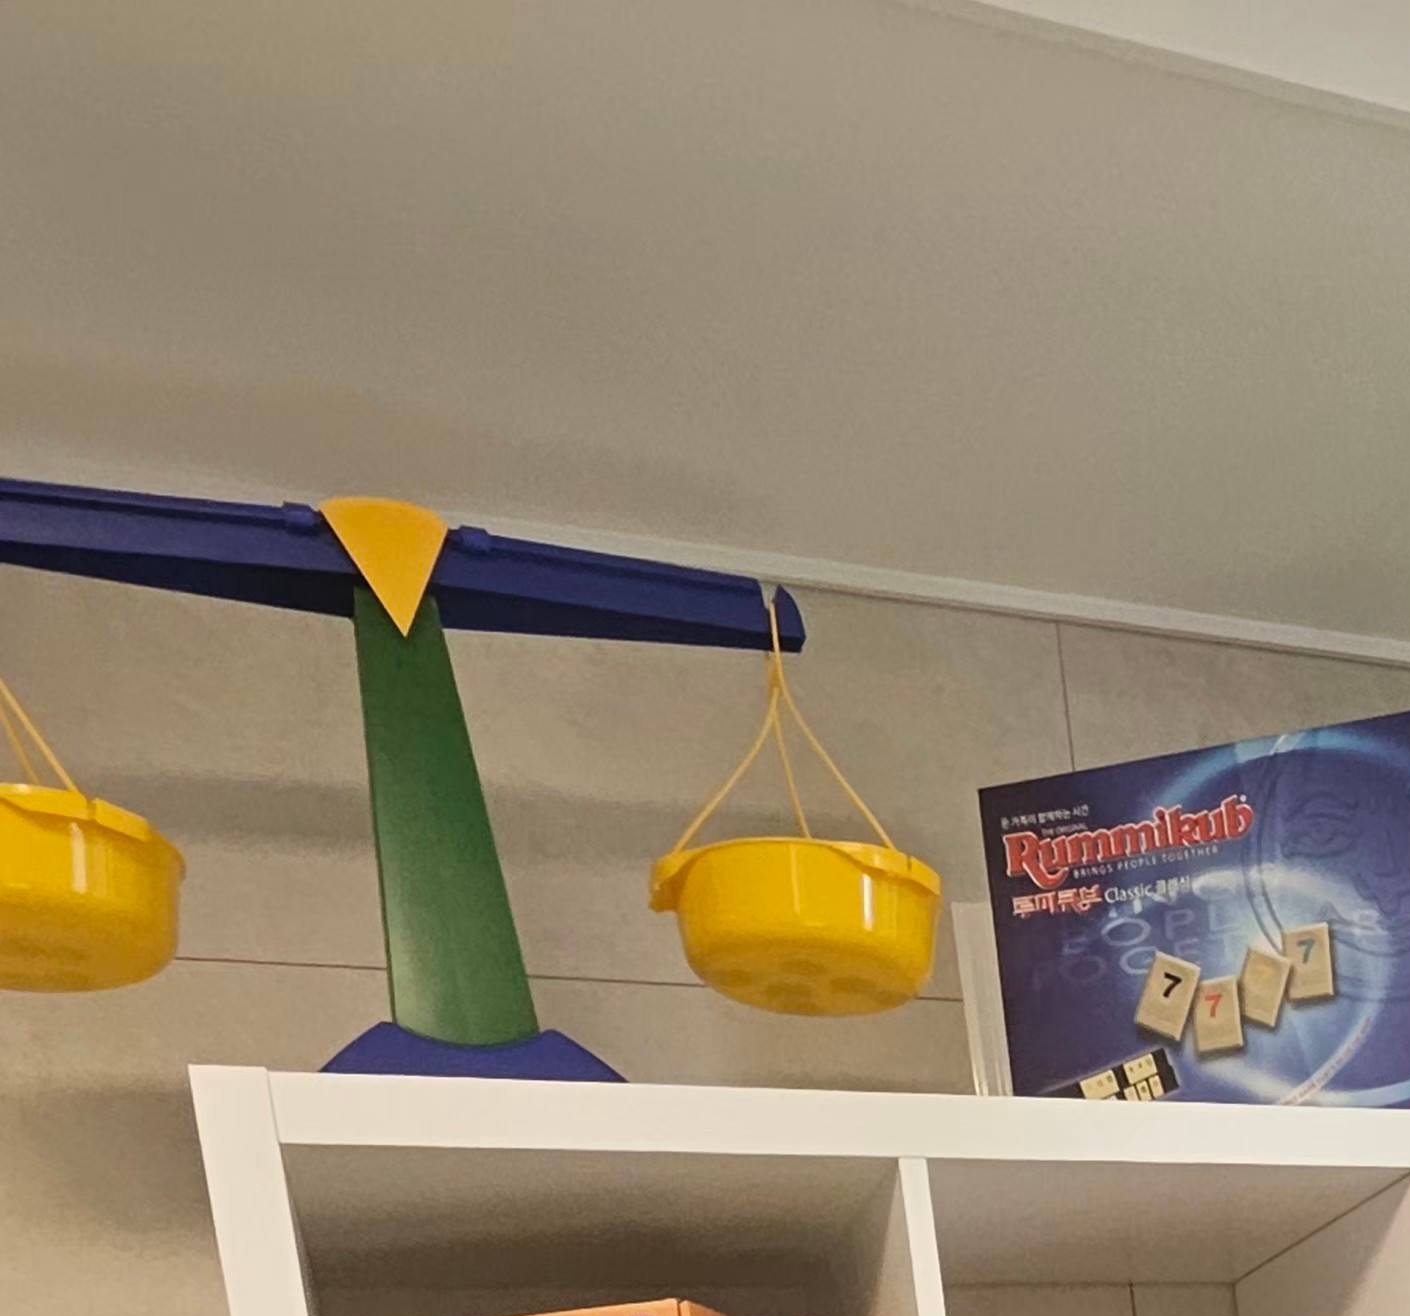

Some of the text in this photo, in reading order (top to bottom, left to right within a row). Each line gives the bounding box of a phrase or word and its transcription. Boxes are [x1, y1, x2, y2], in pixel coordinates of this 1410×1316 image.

[1003, 794, 1255, 889] Rummikub
[1073, 844, 1218, 879] BRINGS PEOPLE TOGETHER
[1104, 882, 1152, 904] Classic
[1297, 938, 1316, 964] 7
[1162, 971, 1182, 998] 7
[1204, 993, 1224, 1018] 7
